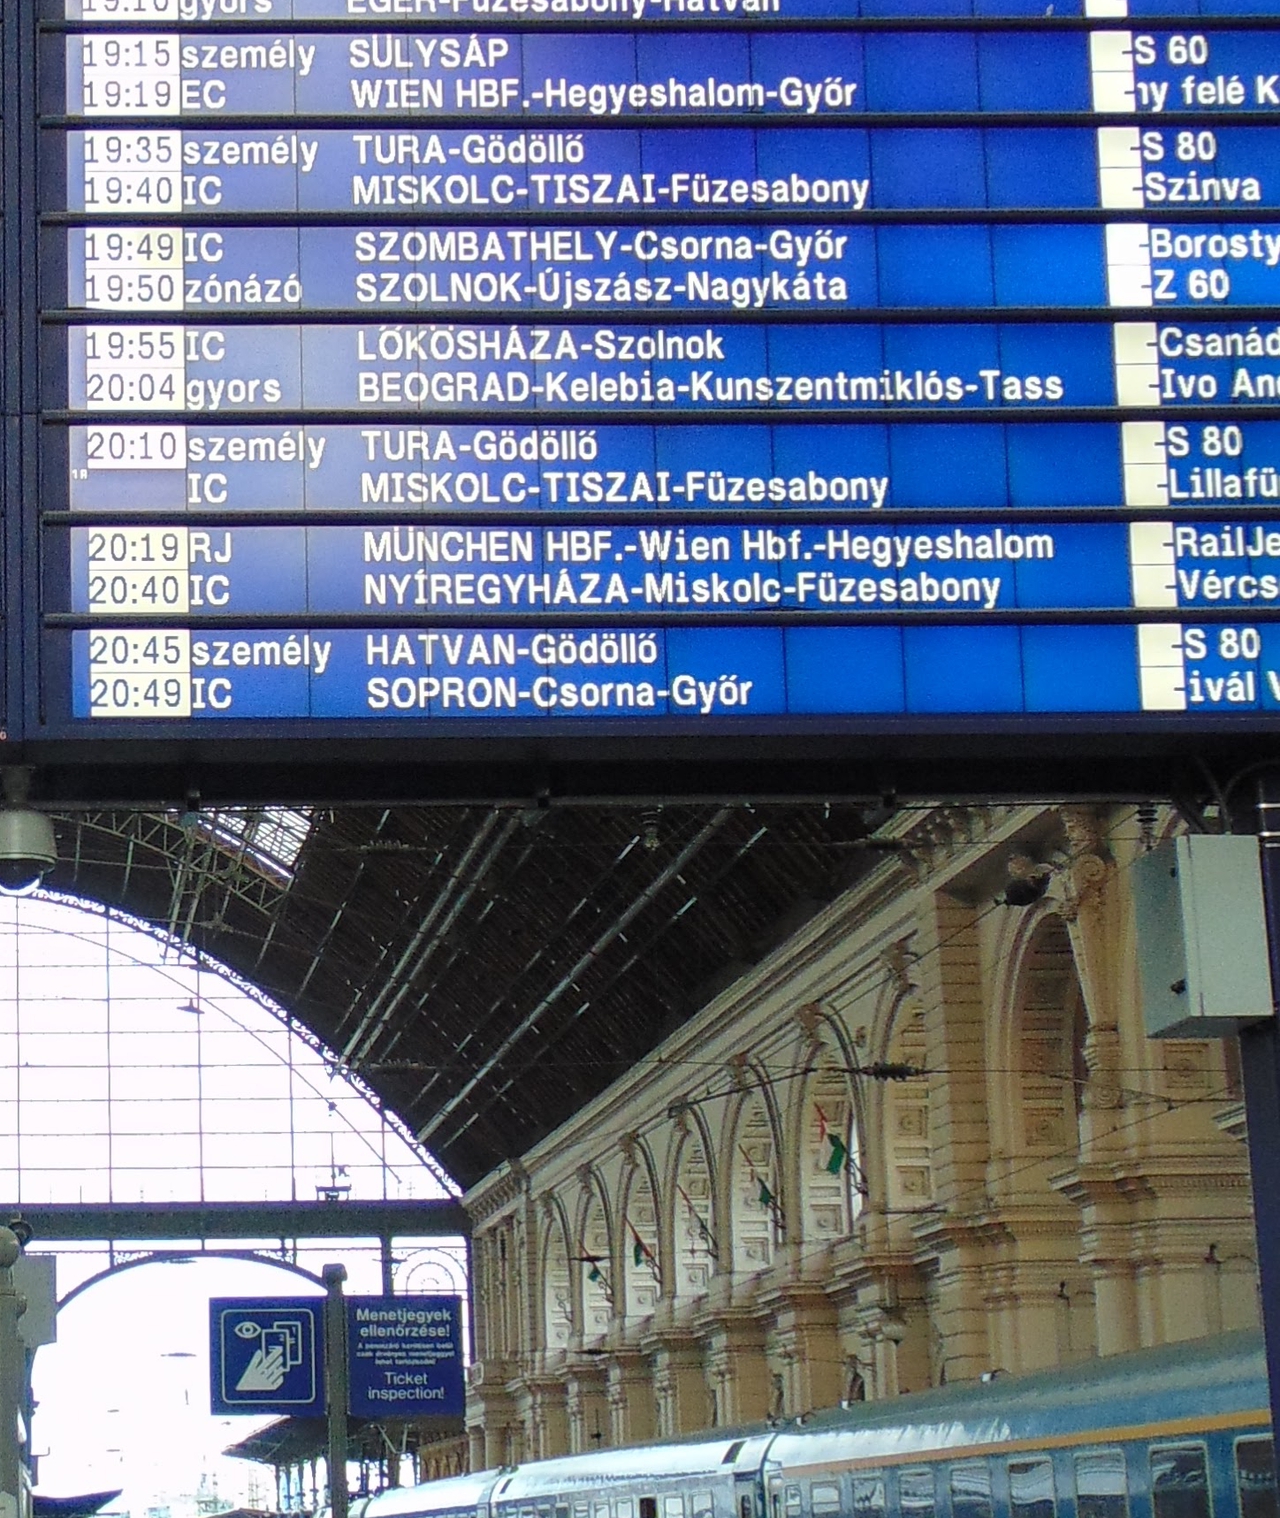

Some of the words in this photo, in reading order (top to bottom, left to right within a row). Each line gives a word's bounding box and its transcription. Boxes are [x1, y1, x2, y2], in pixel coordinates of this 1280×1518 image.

[84, 41, 170, 68] 19:15
[182, 39, 315, 75] személy
[1169, 37, 1208, 64] 60
[84, 81, 171, 108] 19:19
[182, 80, 226, 109] EC
[351, 79, 442, 109] WIEN
[456, 77, 857, 114] HBF.-Hegyeshalom-Győr
[85, 136, 172, 163] 19:35
[183, 135, 318, 172] személy
[353, 133, 584, 165] TURA-Gödöllő
[1177, 132, 1216, 161] 80
[85, 177, 172, 204] 19:40
[183, 176, 222, 205] IC
[353, 173, 870, 210] MISKOLC-TISZAI-Füzesabony
[1145, 171, 1260, 201] Szinva
[85, 233, 173, 261] 19:49
[184, 233, 224, 262] IC
[355, 229, 847, 267] SZOMBATHELY-Csorna-Győr
[86, 275, 173, 302] 19:50
[184, 274, 302, 303] zónázó
[356, 267, 847, 308] SZOLNOK-Újszász-Nagykáta
[1189, 270, 1229, 299] 60
[86, 332, 174, 359] 19:55
[186, 331, 226, 361] IC
[357, 325, 725, 361] LŐKÖSHÁZA-Szolnok
[87, 374, 175, 402] 20:04
[186, 377, 281, 410] gyors
[358, 369, 1063, 403] BEOGRAD-Kelebia-Kunszentmiklós-Tass
[1161, 369, 1216, 399] Ivo
[87, 433, 176, 460] 20:10
[188, 431, 325, 469] személy
[361, 428, 598, 461] TURA-Gödöllő
[1203, 426, 1242, 456] 80
[188, 474, 227, 503] IC
[361, 470, 888, 508] MISKOLC-TISZAI-Füzesabony
[89, 535, 178, 562] 20:19
[189, 533, 233, 563] RJ
[364, 527, 533, 563] MÜNCHEN
[547, 530, 730, 563] HBF.-Wien
[742, 528, 1054, 567] Hbf.-Hegyeshalom
[89, 576, 179, 604] 20:40
[191, 576, 230, 605] IC
[364, 570, 1000, 608] NYÍREGYHÁZA-Miskolc-Füzesabony
[90, 637, 180, 664] 20:45
[192, 635, 331, 673] személy
[367, 632, 657, 666] HATVAN-Gödöllő
[1221, 629, 1260, 658] 80
[91, 680, 181, 708] 20:49
[192, 679, 232, 709] IC
[368, 674, 752, 713] SOPRON-Csorna-Győr
[357, 1307, 451, 1324] Menetjegyek
[360, 1323, 450, 1337] ellenőrzése!
[368, 1386, 444, 1401] inspection!
[384, 1371, 428, 1385] Ticket
